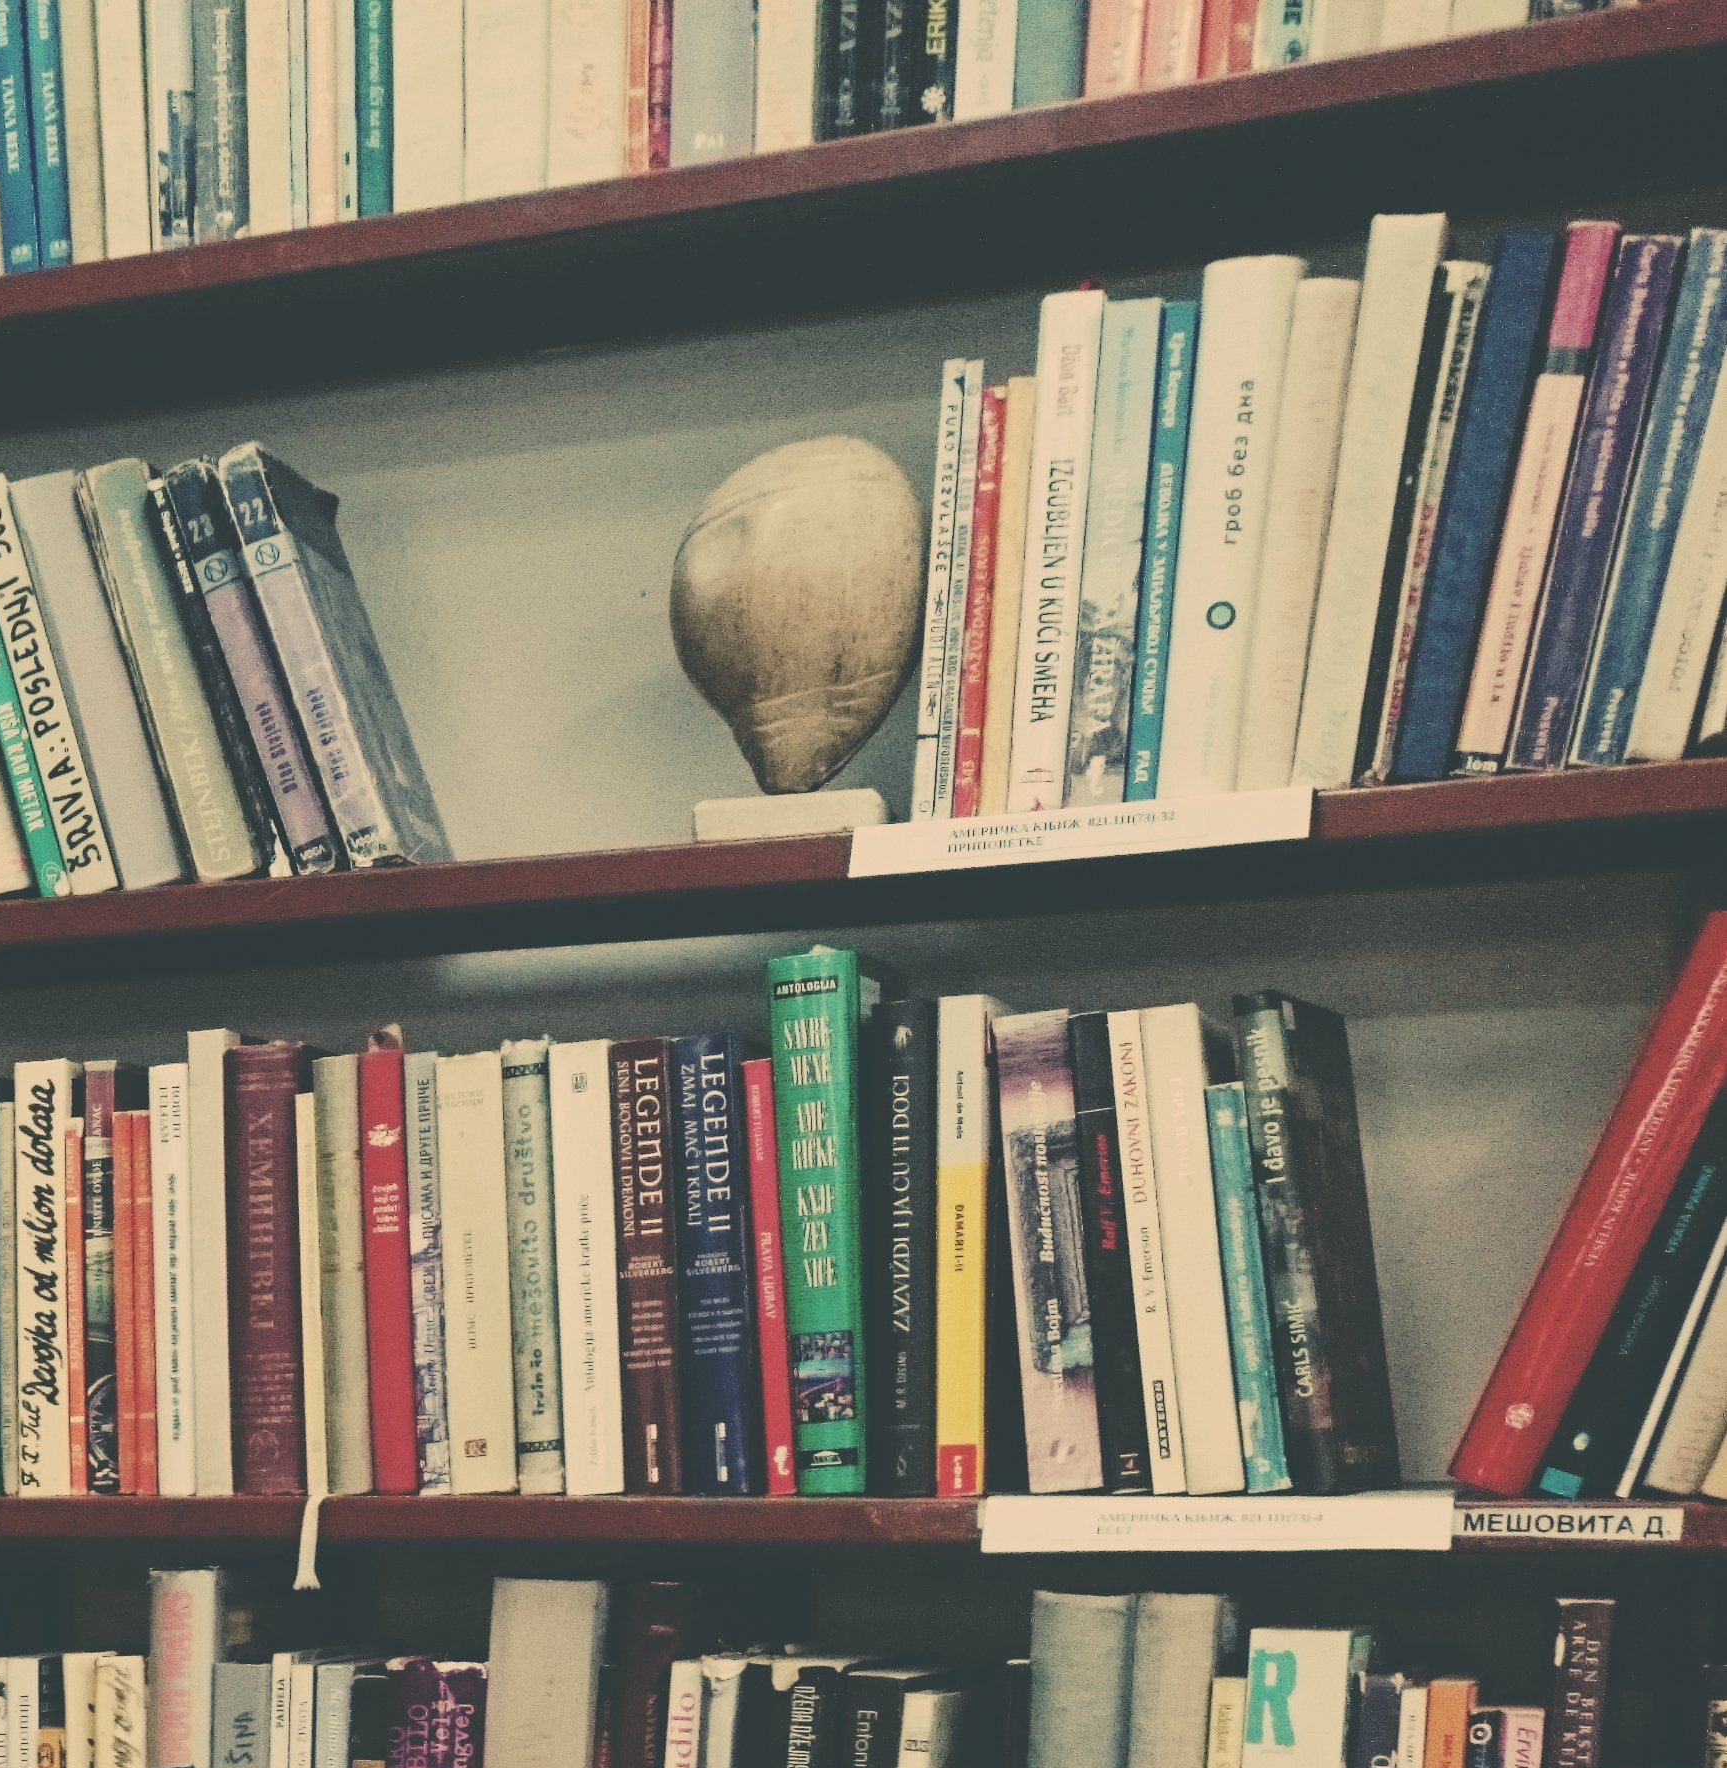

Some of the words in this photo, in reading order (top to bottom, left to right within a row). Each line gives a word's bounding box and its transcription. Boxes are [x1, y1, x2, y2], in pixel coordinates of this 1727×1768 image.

[1236, 377, 1258, 424] дна
[1226, 433, 1249, 476] без
[237, 497, 264, 523] 22
[1039, 456, 1074, 569] IZGUBLJEN
[1218, 486, 1246, 546] гроб
[1040, 574, 1065, 594] U
[1036, 598, 1070, 646] KUĆI
[1031, 651, 1059, 725] SMEHA
[947, 836, 1045, 852] ПРИПОВЕТКЕ
[776, 978, 837, 994] ANTOLOGIJA
[249, 1109, 274, 1329] ХЕМИНГВЕЈ
[1463, 1514, 1633, 1534] МЕШОВИТА
[852, 1709, 877, 1768] Entoni
